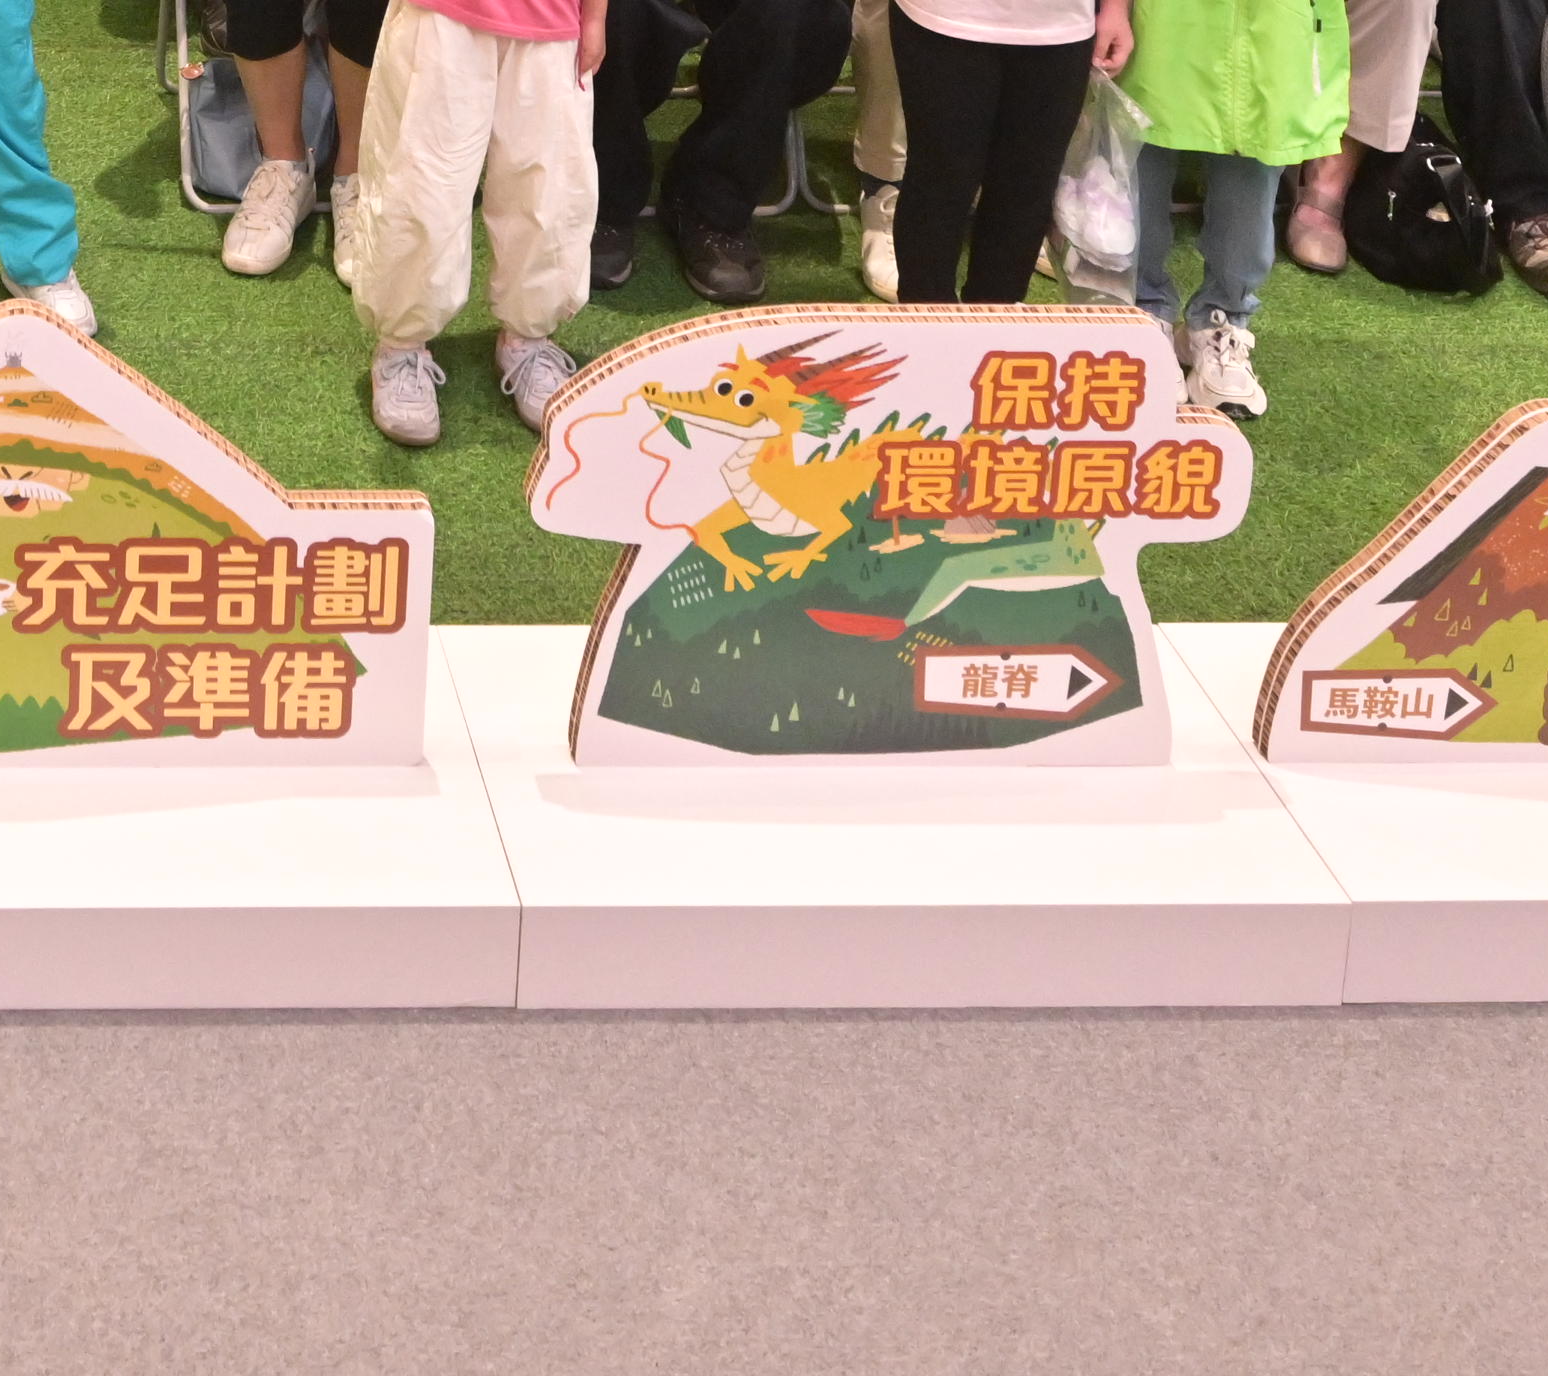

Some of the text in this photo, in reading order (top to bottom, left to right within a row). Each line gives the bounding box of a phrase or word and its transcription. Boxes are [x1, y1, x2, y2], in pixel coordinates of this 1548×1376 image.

[977, 355, 1141, 428] 保持
[879, 446, 1223, 516] 環境原貌
[23, 545, 398, 628] 充足計劃
[65, 650, 349, 733] 及準備
[961, 663, 1040, 700] 龍脊
[1324, 685, 1435, 721] 馬鞍山
